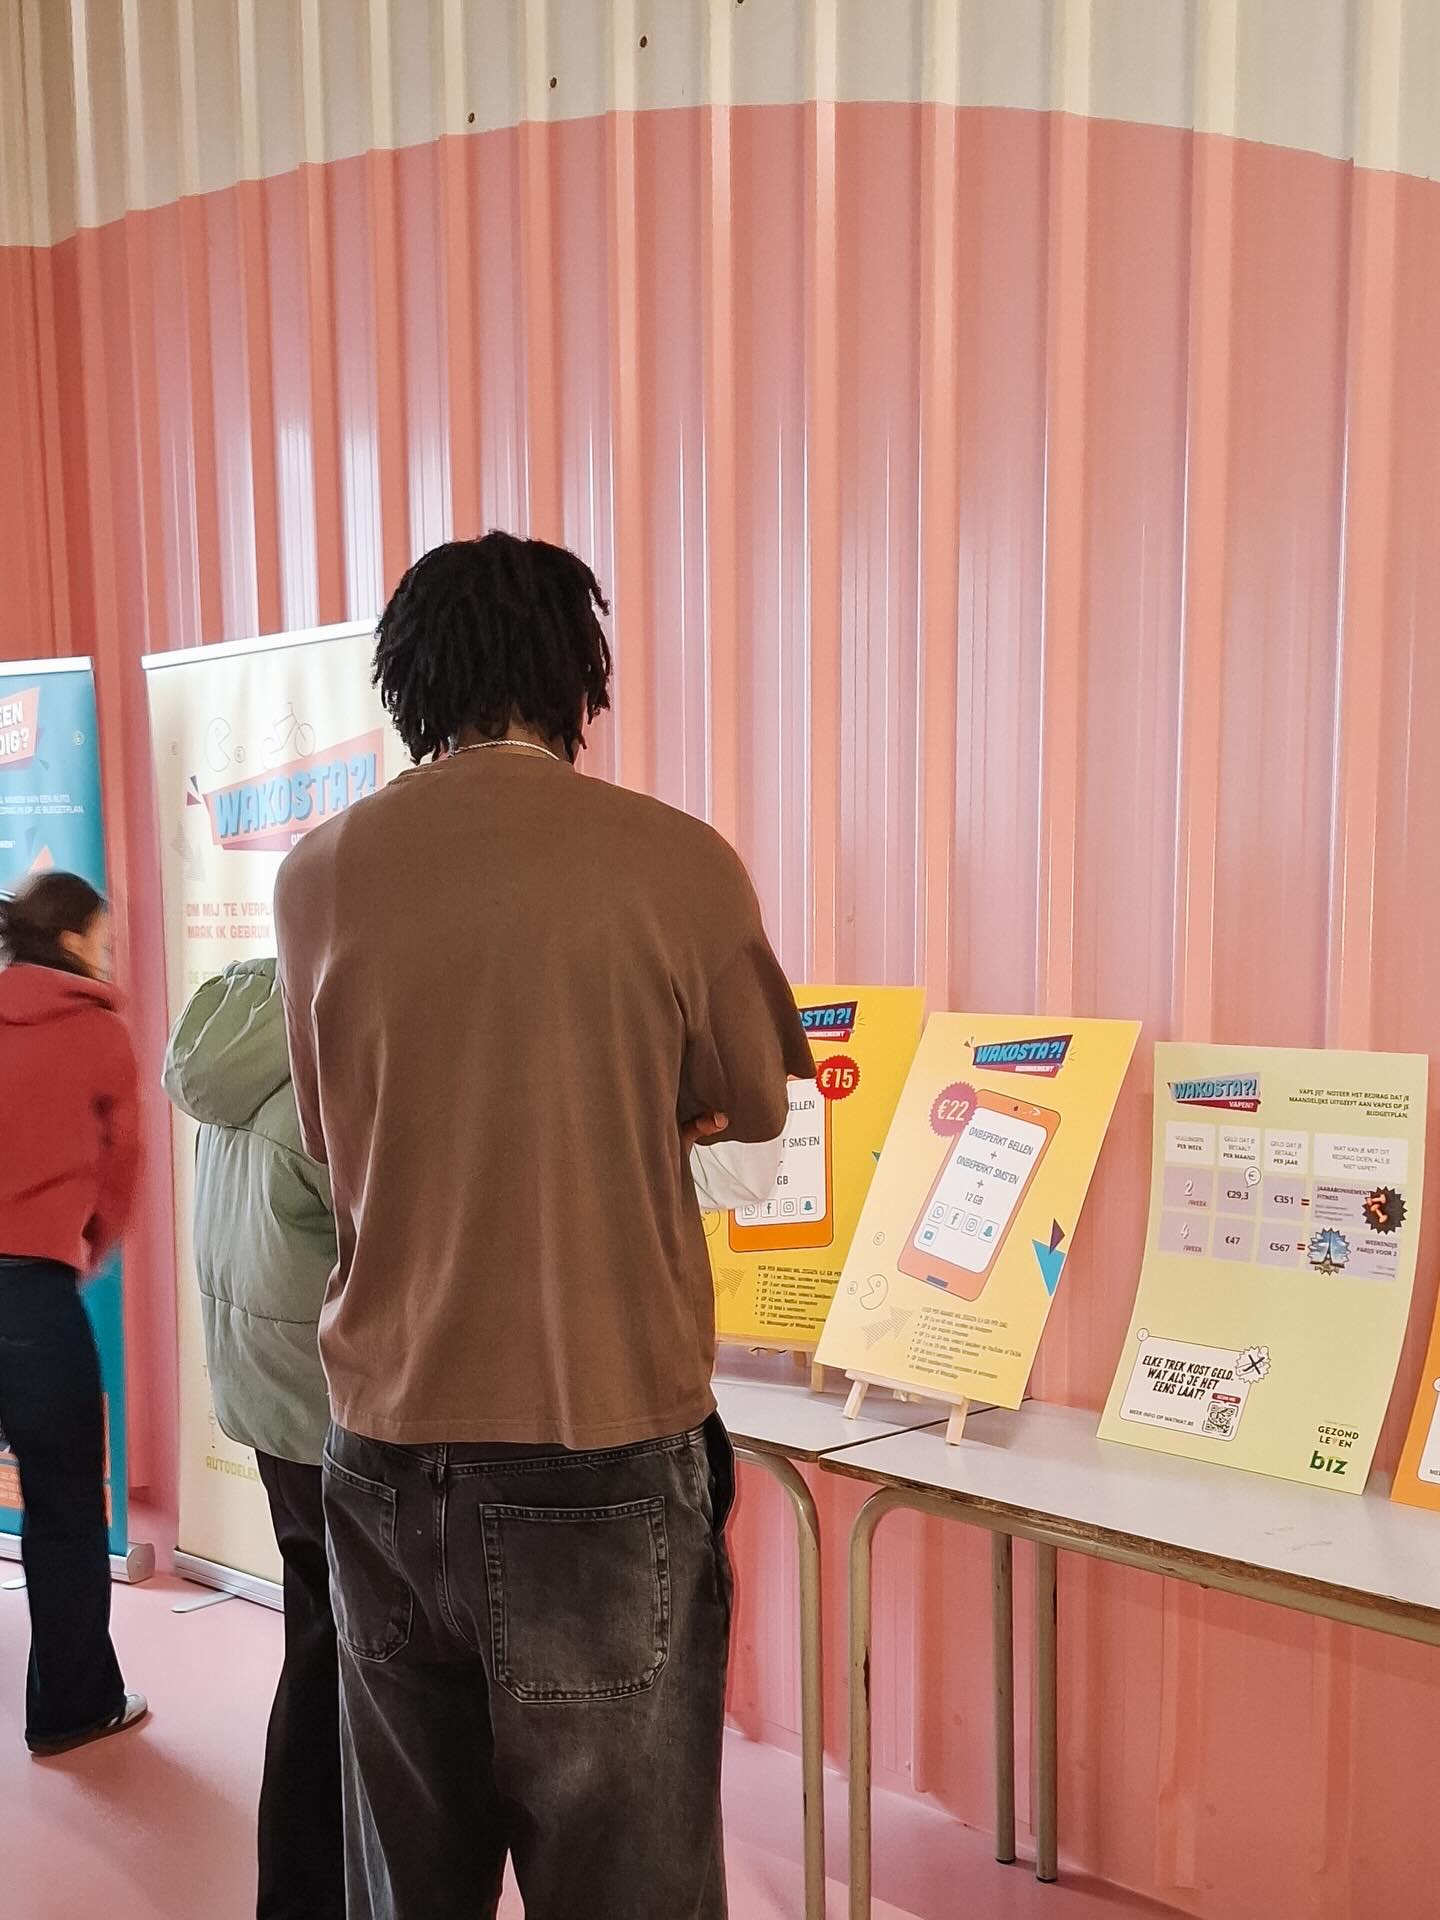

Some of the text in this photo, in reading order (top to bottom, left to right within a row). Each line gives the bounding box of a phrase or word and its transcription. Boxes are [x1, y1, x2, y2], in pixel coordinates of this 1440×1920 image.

[0, 701, 23, 728] EN
[214, 752, 376, 838] WAKOSTA?!
[224, 903, 238, 917] TE
[216, 926, 226, 939] IK
[800, 1008, 852, 1027] STA?!
[976, 1041, 1066, 1063] WAKOSTA?!
[821, 1068, 854, 1089] €15
[1175, 1079, 1258, 1099] WAKOSTA?!
[789, 1101, 815, 1112] ELLEN
[937, 1099, 970, 1121] €22
[1228, 1101, 1255, 1109] VAPEN?
[789, 1136, 820, 1148] SMS'EN
[968, 1127, 1034, 1156] ONBEPERKT BELLEN
[956, 1155, 1020, 1185] ONBEPERKT SMS'EN
[776, 1176, 789, 1186] GB
[965, 1191, 984, 1205] 12 GB
[1226, 1190, 1249, 1201] €29,3
[1273, 1194, 1294, 1205] €351
[1225, 1235, 1241, 1246] €47
[1269, 1242, 1290, 1253] €567
[1142, 1354, 1235, 1382] ELKE TREK KOST GELD.
[1147, 1368, 1221, 1391] WAT ALS JE HET
[1152, 1380, 1177, 1395] EENS
[1177, 1385, 1206, 1401] LAAT?
[1317, 1425, 1359, 1440] GEZOND
[1309, 1450, 1349, 1476] biz
